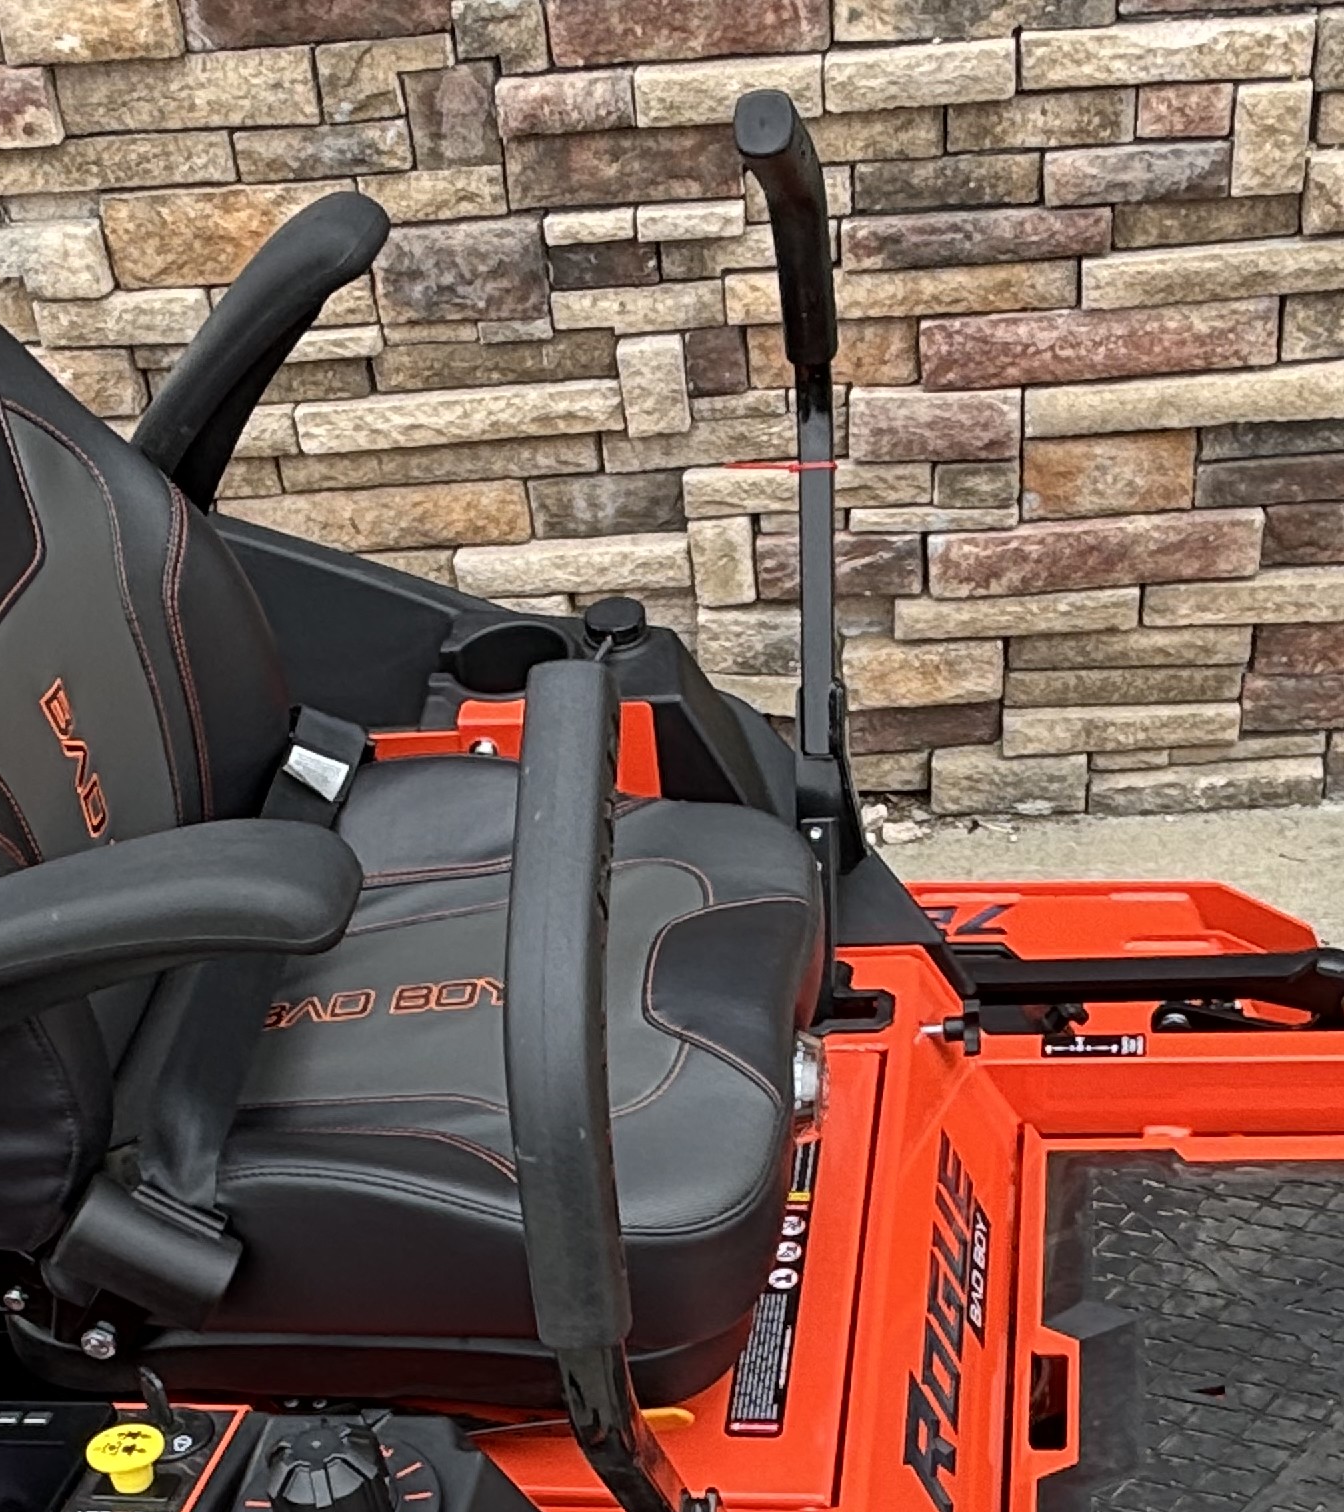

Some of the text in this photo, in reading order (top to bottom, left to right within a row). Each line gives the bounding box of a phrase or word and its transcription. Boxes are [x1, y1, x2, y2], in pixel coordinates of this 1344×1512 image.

[39, 677, 109, 838] BAD
[969, 1211, 987, 1328] BAD BOY
